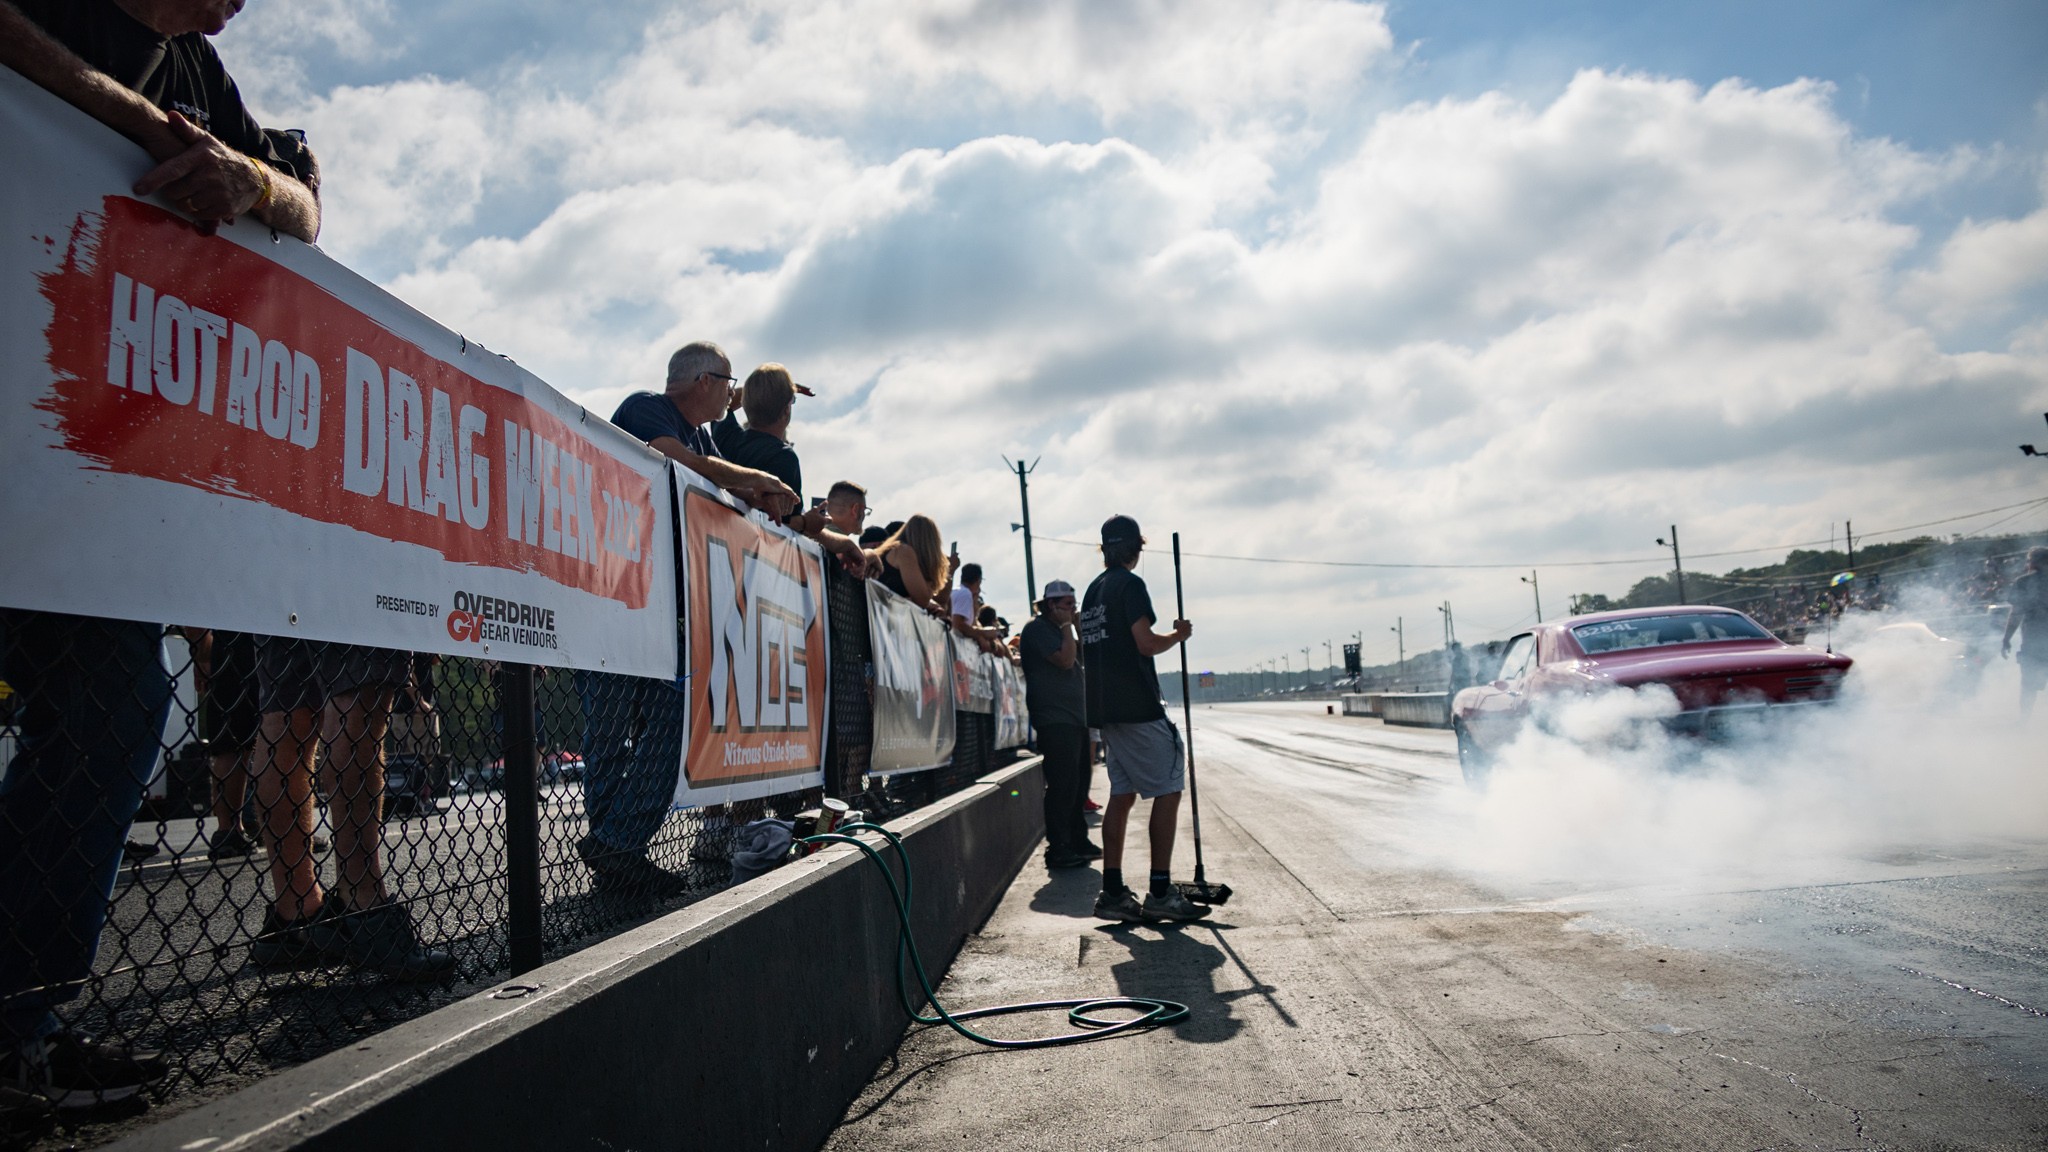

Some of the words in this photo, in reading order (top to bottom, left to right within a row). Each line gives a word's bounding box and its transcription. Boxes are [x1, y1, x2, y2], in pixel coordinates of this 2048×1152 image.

[107, 271, 227, 416] HOT
[226, 321, 321, 450] ROD
[343, 346, 489, 530] DRAG
[504, 419, 597, 567] WEEK
[376, 594, 427, 616] PRESENTED
[429, 604, 439, 618] BY
[454, 590, 555, 631] OVERDRIVE
[480, 621, 510, 642] GEAR
[512, 627, 557, 650] VENDORS
[708, 537, 816, 732] NOS
[723, 741, 760, 767] Nitrous
[763, 741, 784, 763] Oxide
